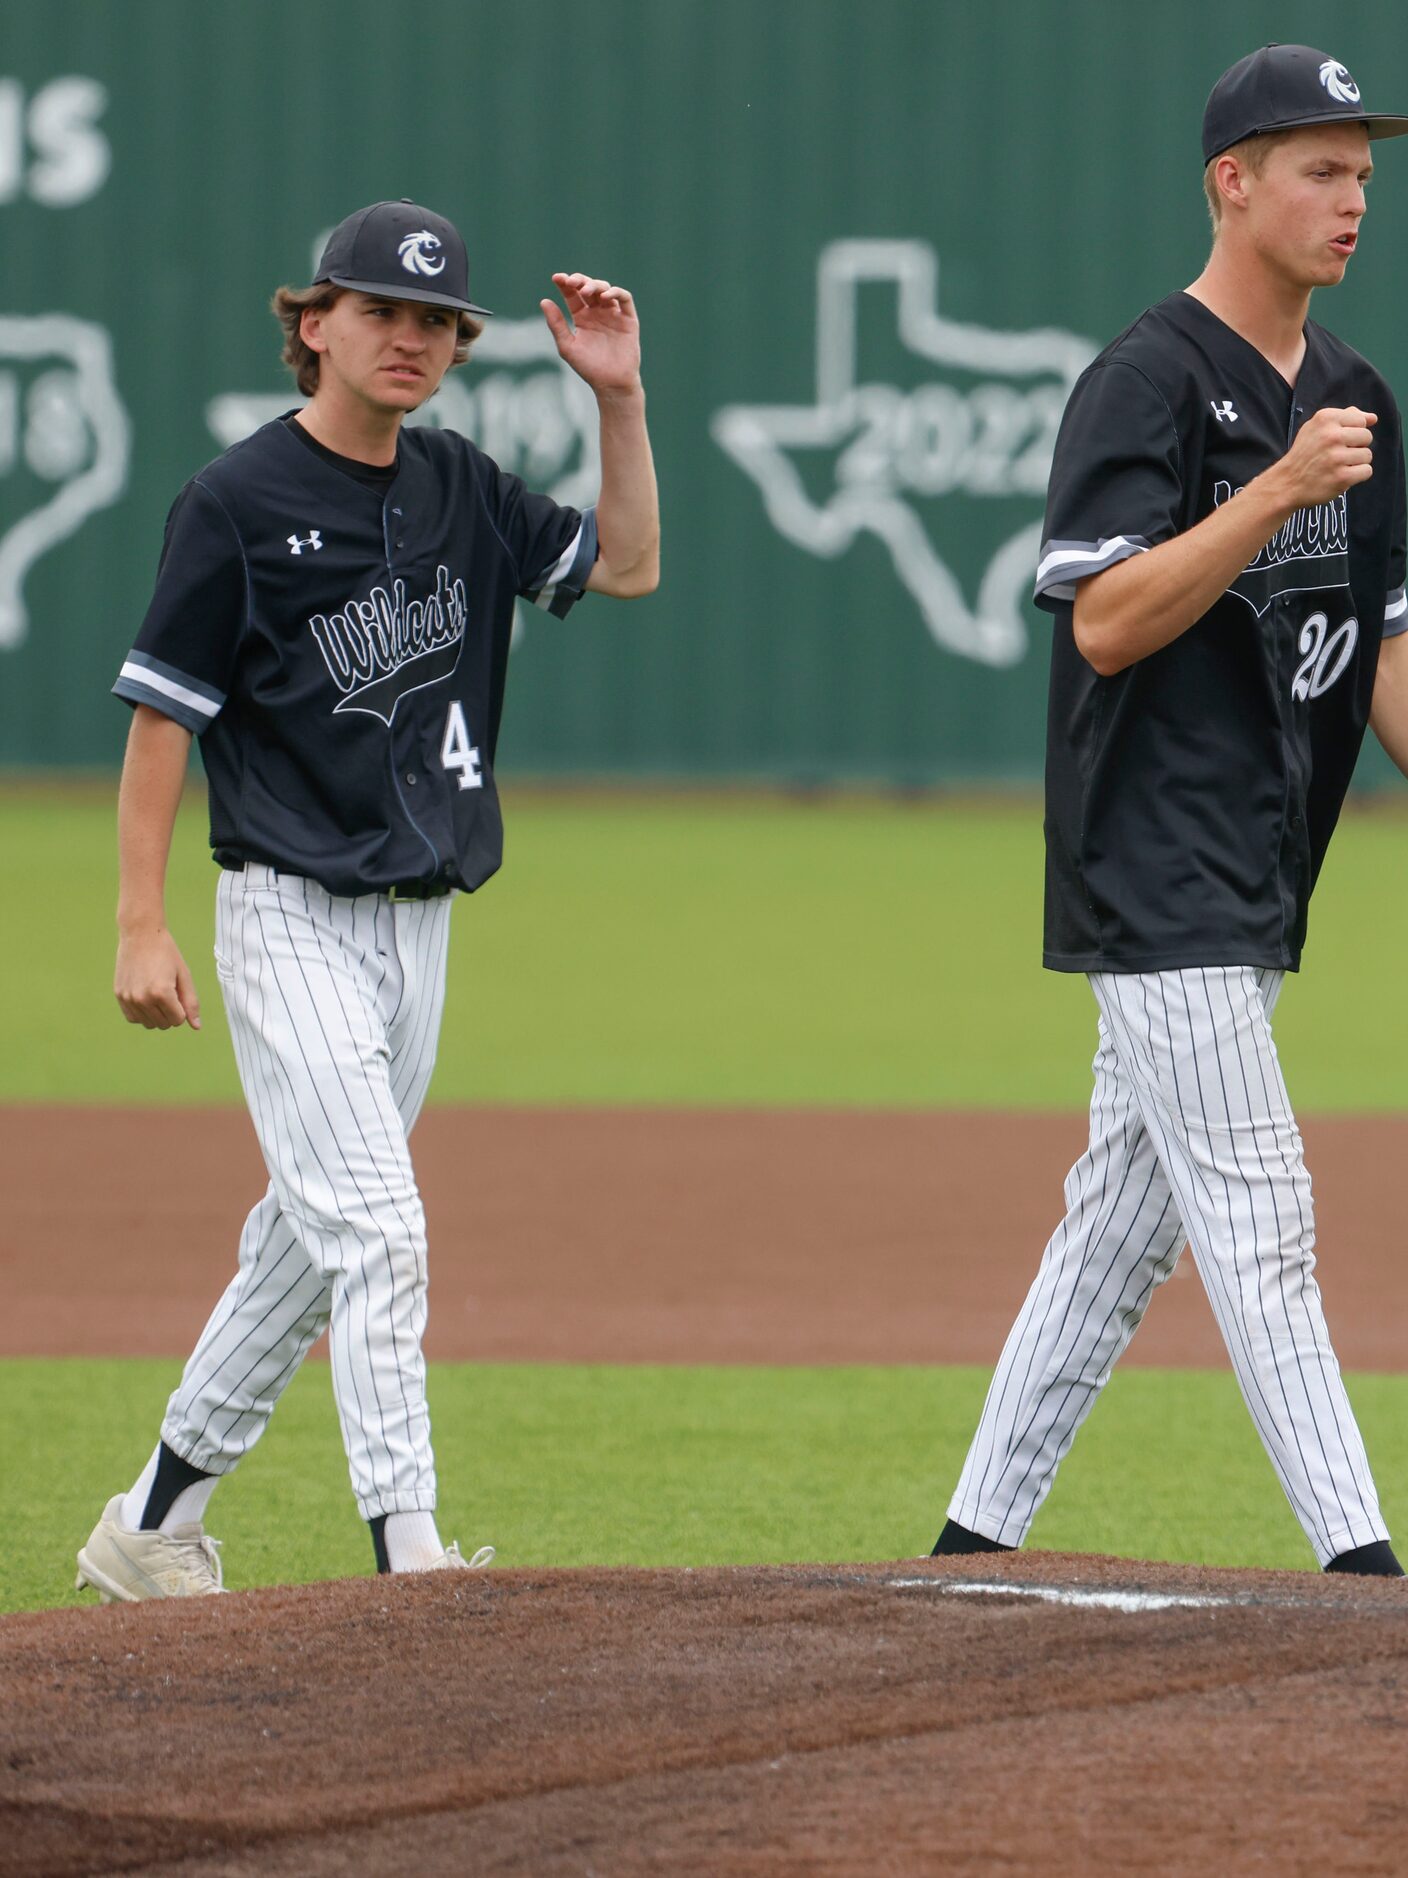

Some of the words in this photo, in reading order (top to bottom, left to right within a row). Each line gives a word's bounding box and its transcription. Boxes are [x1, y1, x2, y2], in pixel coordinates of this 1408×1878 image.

[836, 381, 1066, 496] 2022
[309, 565, 467, 692] Wildcats
[1291, 611, 1359, 703] 20
[440, 700, 483, 791] 4
